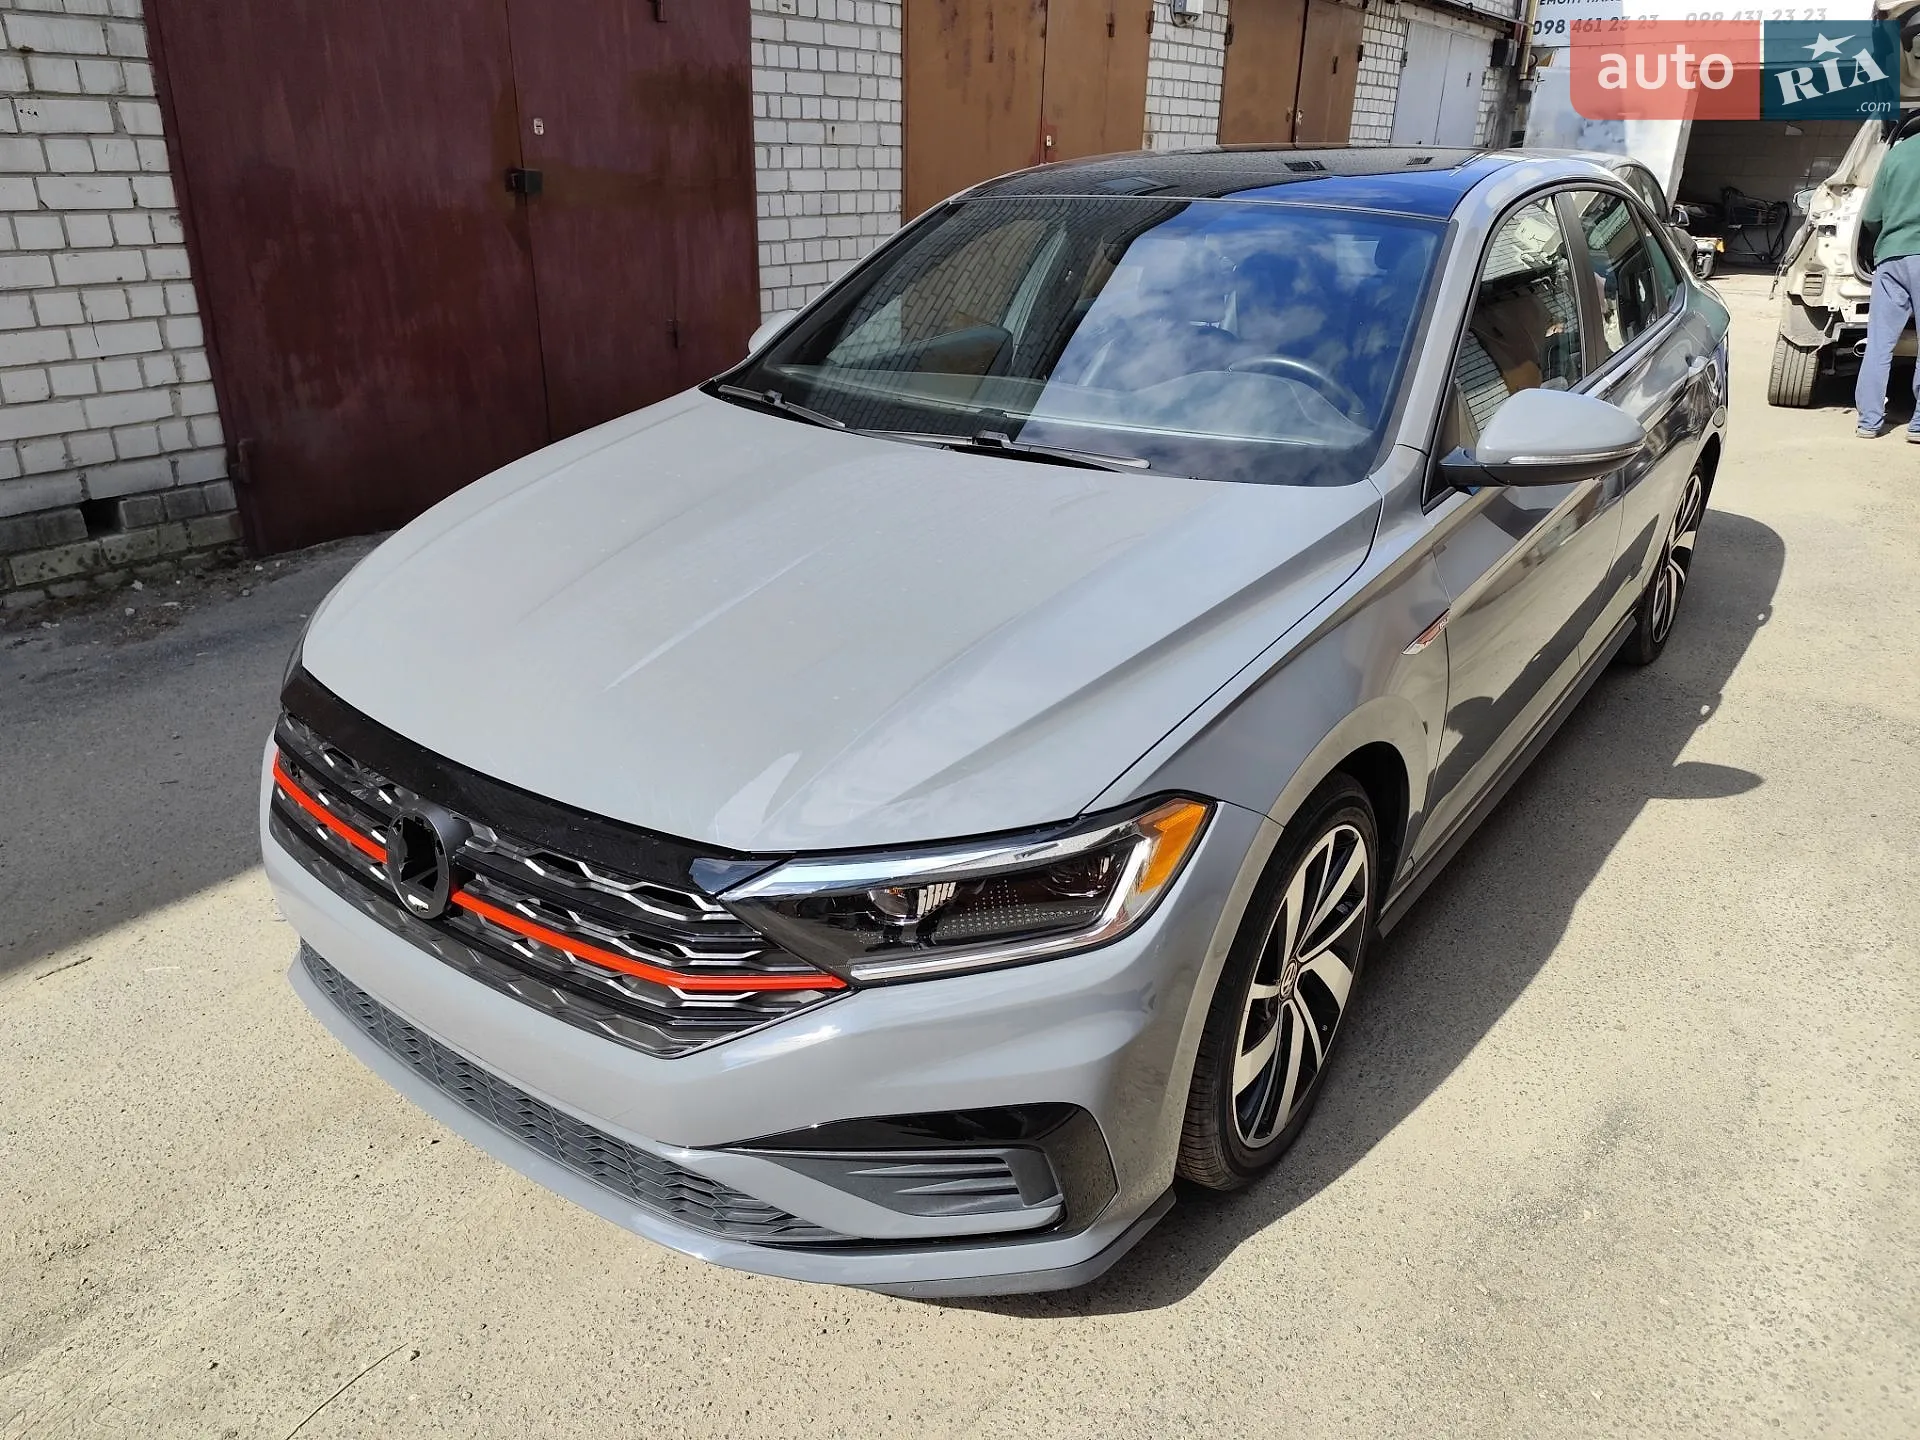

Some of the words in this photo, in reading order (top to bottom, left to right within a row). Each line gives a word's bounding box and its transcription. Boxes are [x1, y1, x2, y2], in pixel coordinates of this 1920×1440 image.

[1533, 19, 1565, 35] 098
[1571, 17, 1602, 33] 461
[1608, 16, 1631, 31] 23
[1636, 14, 1660, 30] 23
[1684, 11, 1724, 28] 099
[1729, 10, 1763, 26] 431
[1771, 9, 1796, 24] 23
[1803, 8, 1828, 23] 23
